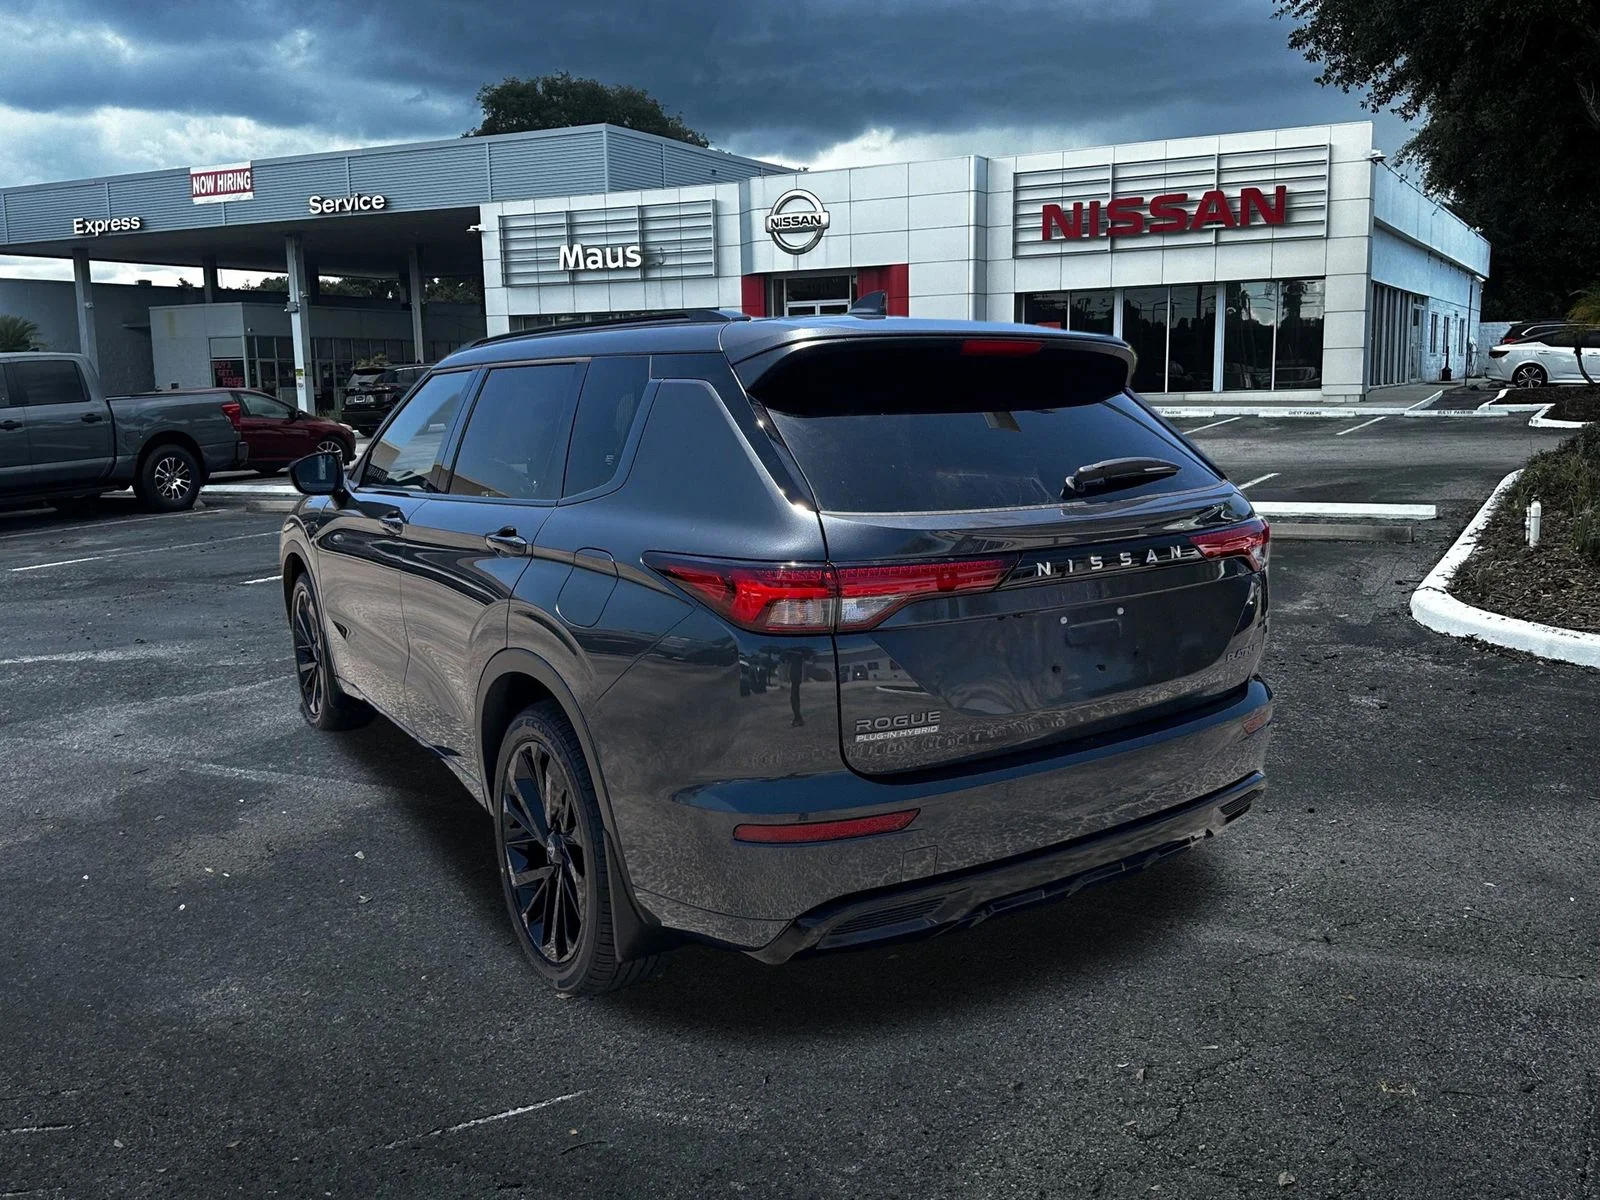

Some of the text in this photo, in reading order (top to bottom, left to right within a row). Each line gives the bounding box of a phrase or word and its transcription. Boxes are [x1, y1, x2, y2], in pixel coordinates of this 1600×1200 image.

[192, 171, 251, 195] NOW HIRING
[309, 192, 385, 214] Service
[1042, 185, 1287, 241] NISSAN
[73, 216, 141, 237] Express
[770, 214, 822, 228] NISSAN
[559, 243, 642, 270] Maus
[223, 377, 244, 387] FREE
[1036, 545, 1182, 577] NISSAN
[856, 711, 941, 732] ROGUE
[856, 725, 939, 743] PLUG-IN HYBRID
